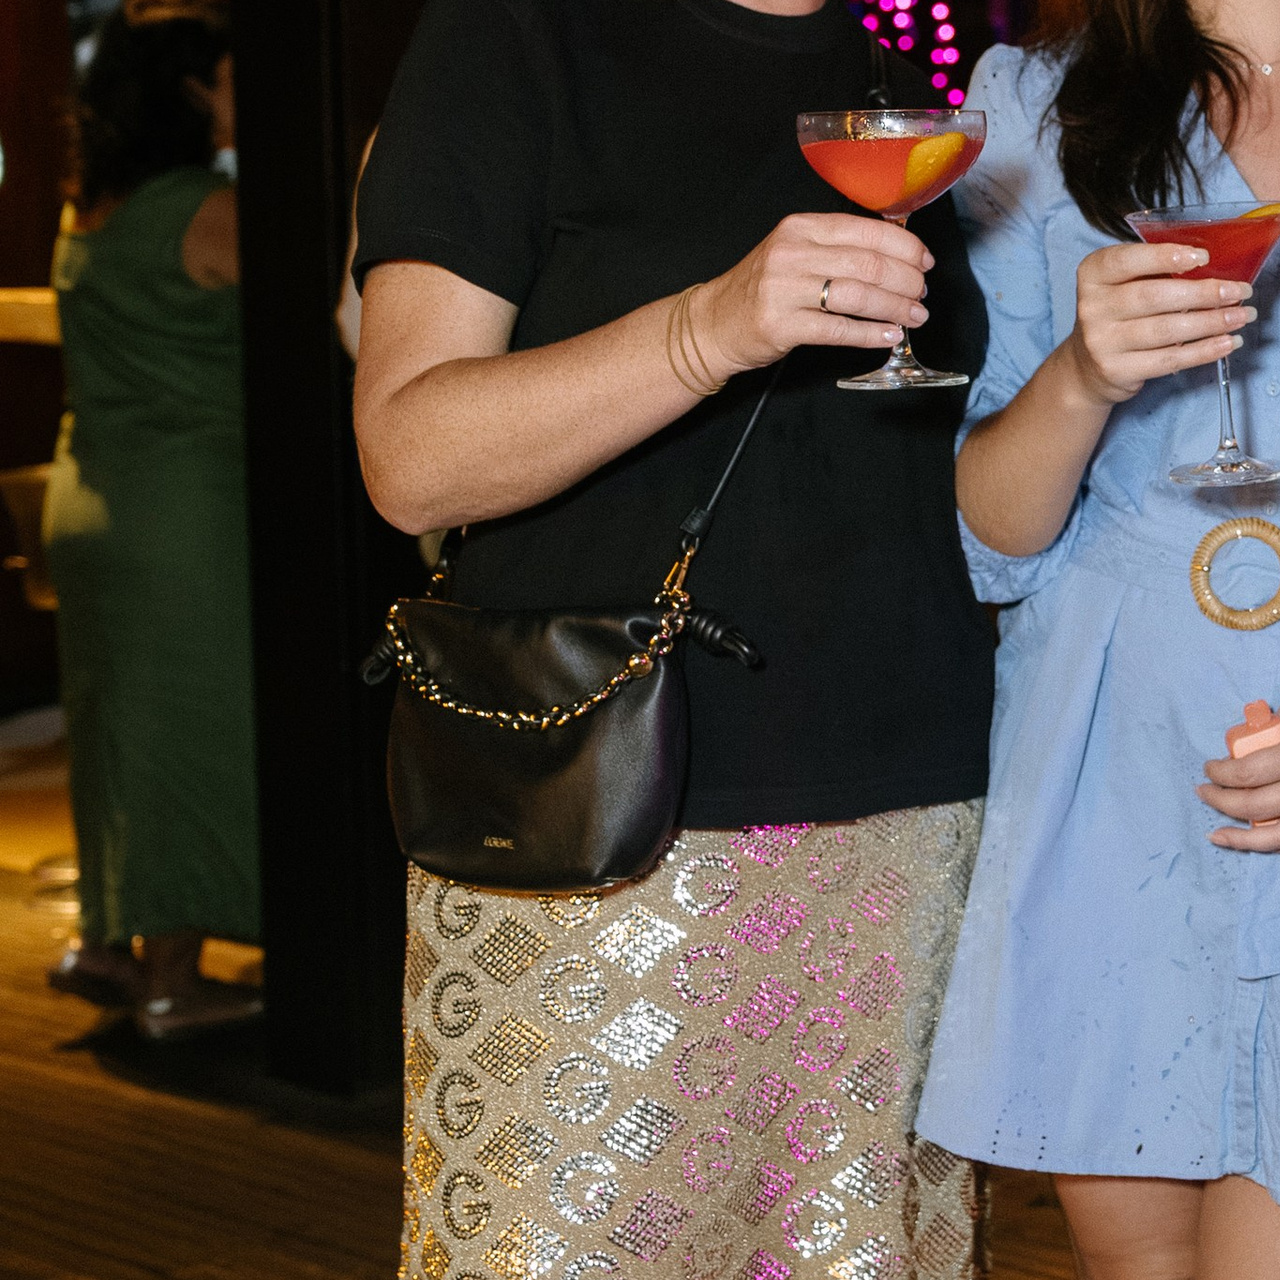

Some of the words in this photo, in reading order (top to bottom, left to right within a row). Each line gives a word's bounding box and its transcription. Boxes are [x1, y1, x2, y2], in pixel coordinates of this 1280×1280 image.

[672, 852, 740, 917] G
[807, 828, 859, 894] G
[434, 883, 482, 940] G
[671, 941, 739, 1007] G
[800, 917, 857, 983] G
[432, 971, 482, 1038] G
[539, 954, 606, 1023] G
[673, 1034, 738, 1100] G
[791, 1006, 849, 1071] G
[435, 1070, 485, 1139] G
[544, 1052, 611, 1124] G
[681, 1125, 734, 1193] G
[785, 1098, 847, 1163] G
[443, 1169, 491, 1240] G
[550, 1151, 619, 1224] G
[781, 1188, 848, 1258] G
